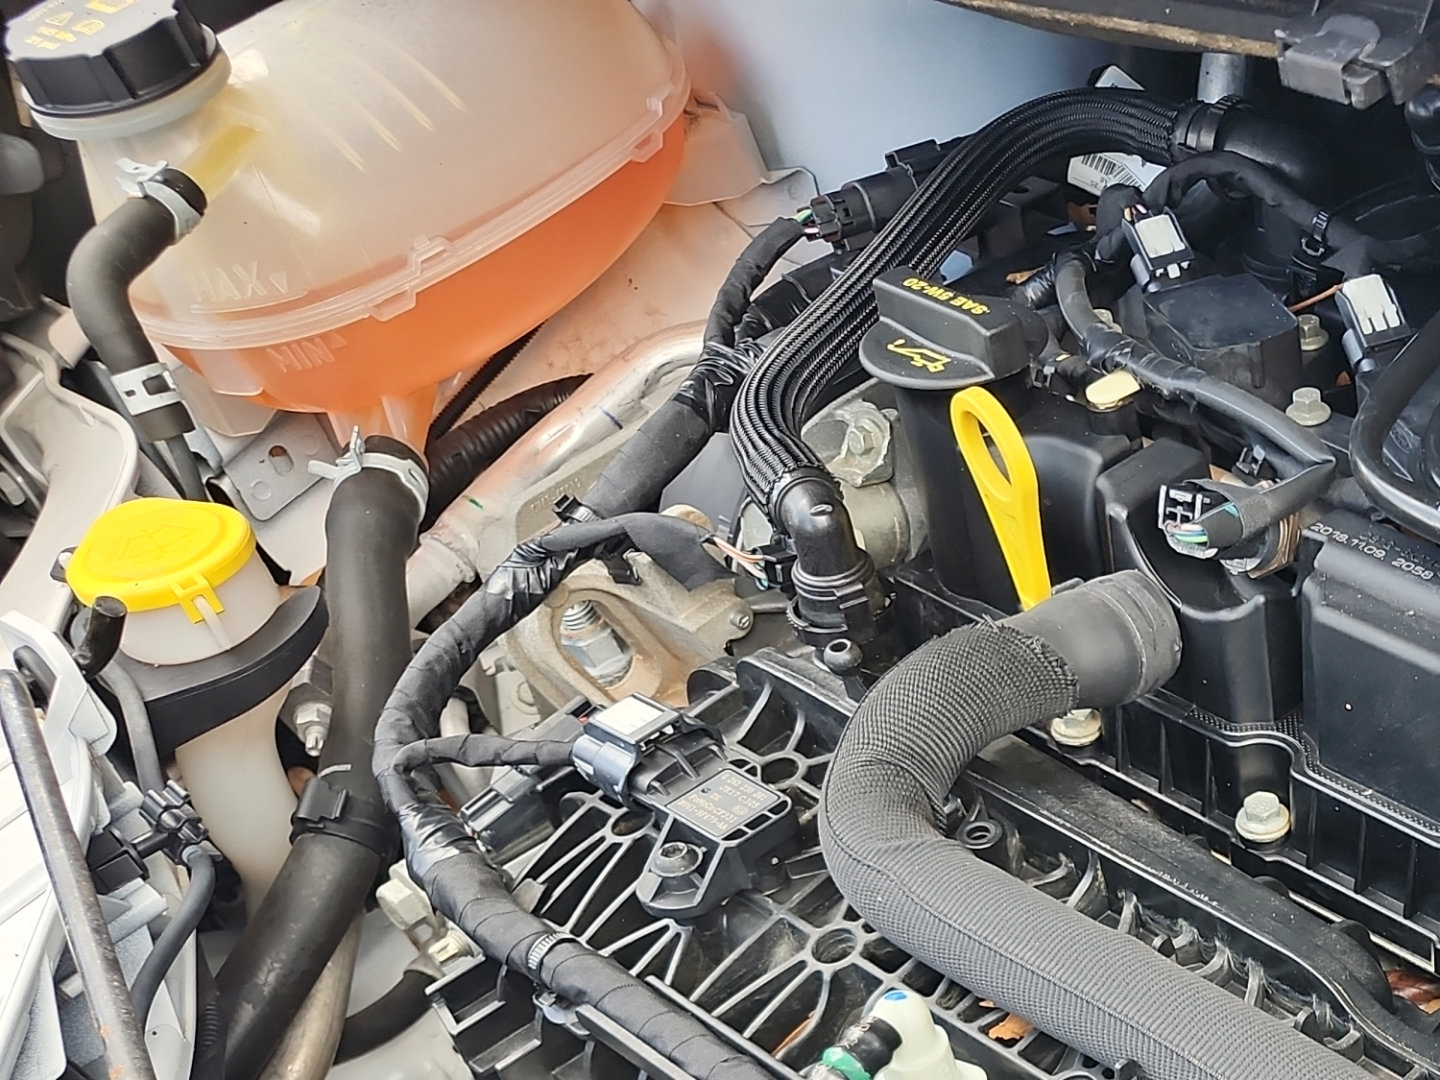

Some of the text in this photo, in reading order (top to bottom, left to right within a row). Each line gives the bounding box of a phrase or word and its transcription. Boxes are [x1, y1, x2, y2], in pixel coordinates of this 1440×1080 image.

[184, 261, 267, 303] MAX
[902, 277, 989, 315] SAE 5W-20
[265, 337, 335, 373] MIN
[1391, 558, 1434, 580] 2058
